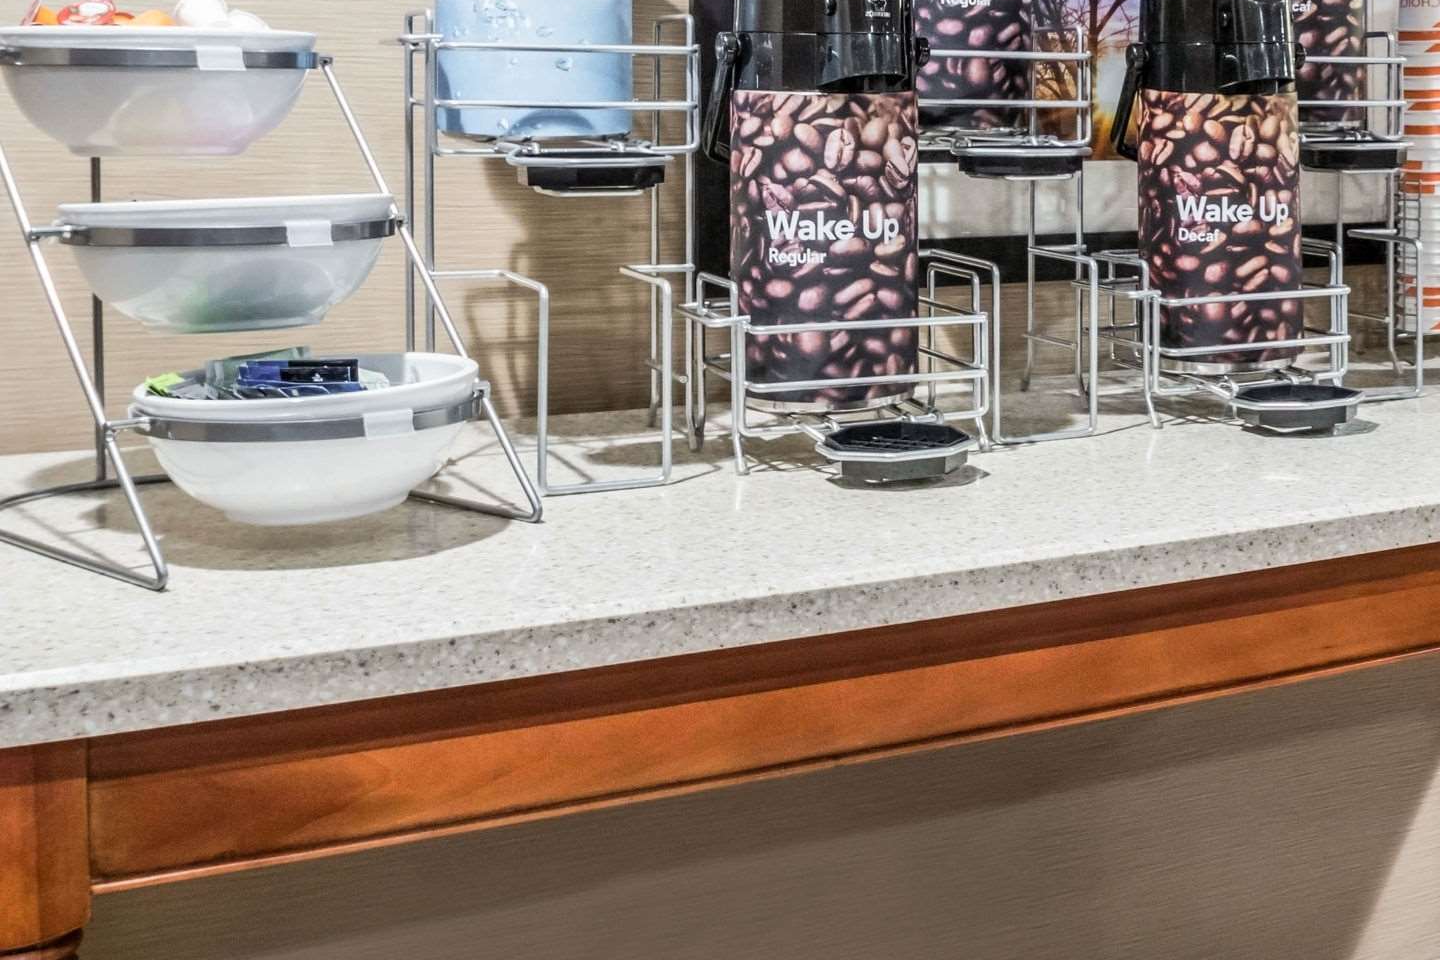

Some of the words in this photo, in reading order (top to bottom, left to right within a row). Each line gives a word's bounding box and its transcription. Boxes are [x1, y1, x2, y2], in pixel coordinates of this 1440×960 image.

[1292, 0, 1312, 12] caf
[1176, 195, 1254, 222] Wake
[1260, 196, 1288, 226] Up
[765, 210, 855, 240] Wake
[862, 210, 898, 244] Up
[1178, 228, 1220, 242] Decaf
[768, 247, 827, 267] Regular
